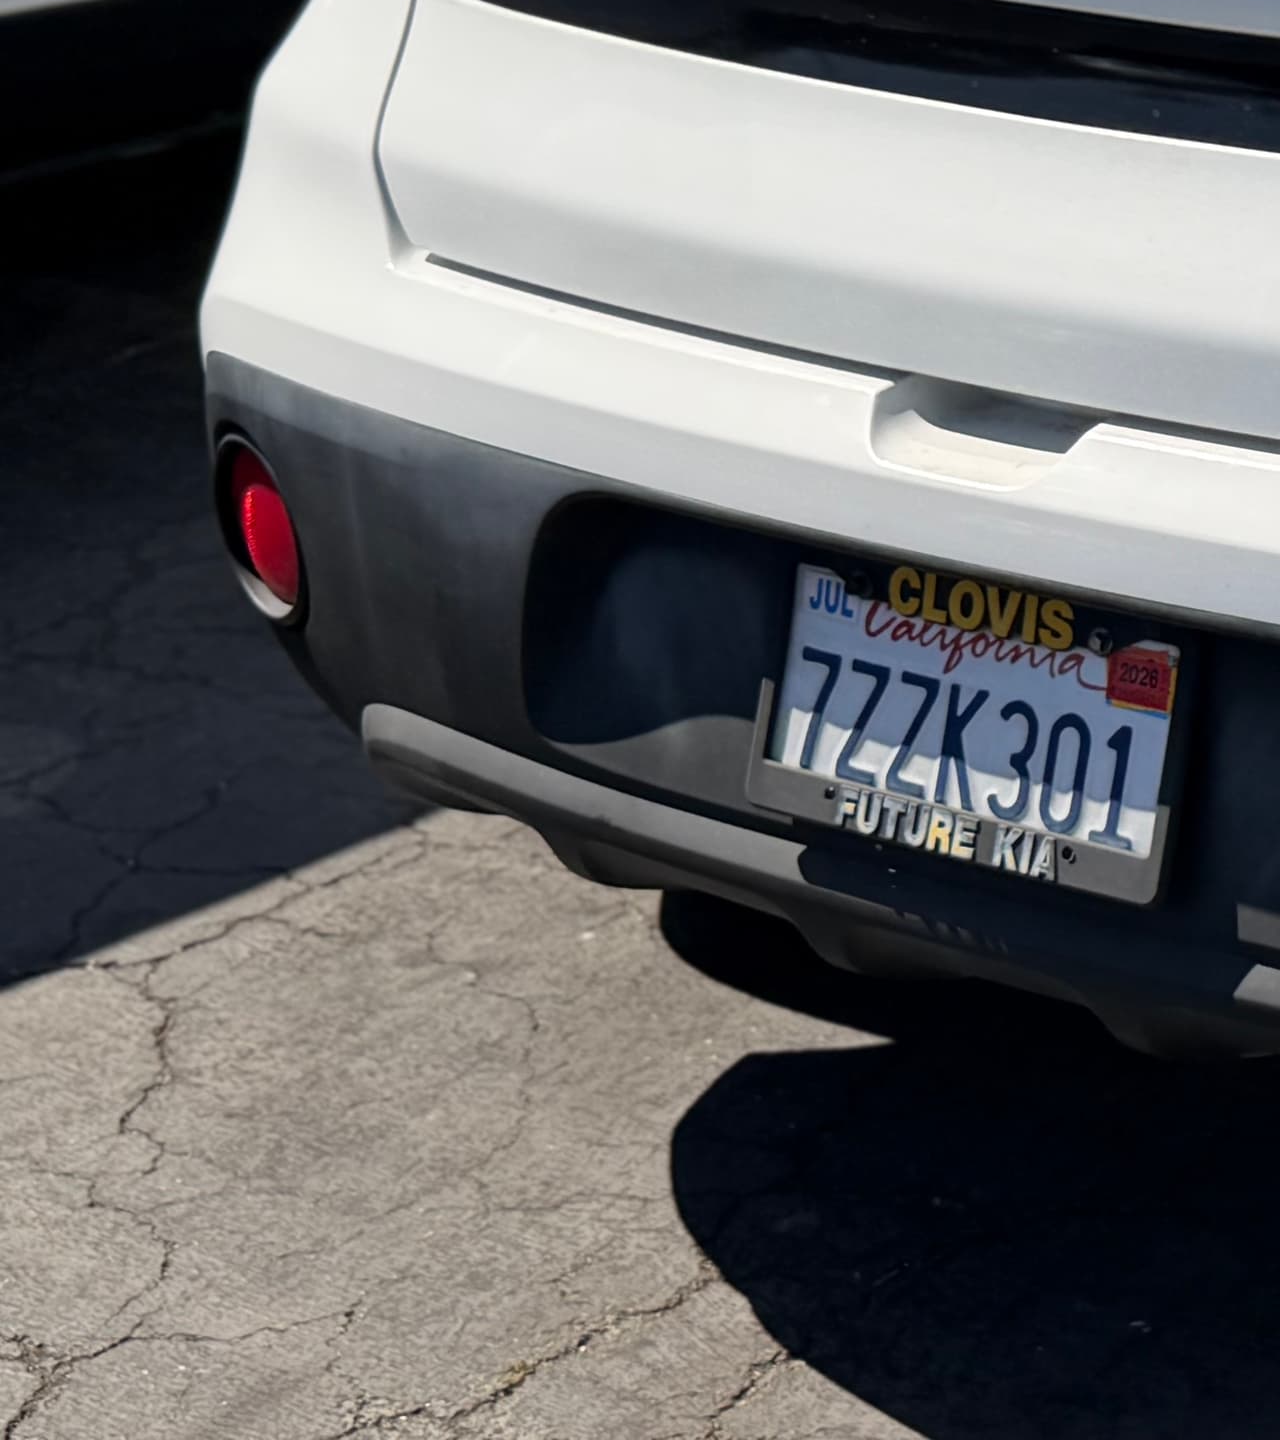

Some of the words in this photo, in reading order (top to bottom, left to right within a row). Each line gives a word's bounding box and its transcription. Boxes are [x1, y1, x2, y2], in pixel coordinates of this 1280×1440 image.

[809, 577, 854, 619] JUL
[888, 566, 1076, 651] CLOVIS
[1120, 662, 1159, 689] 2026
[800, 645, 1134, 852] 7ZZK301
[834, 784, 980, 861] FUTURE
[991, 822, 1060, 882] KIA
